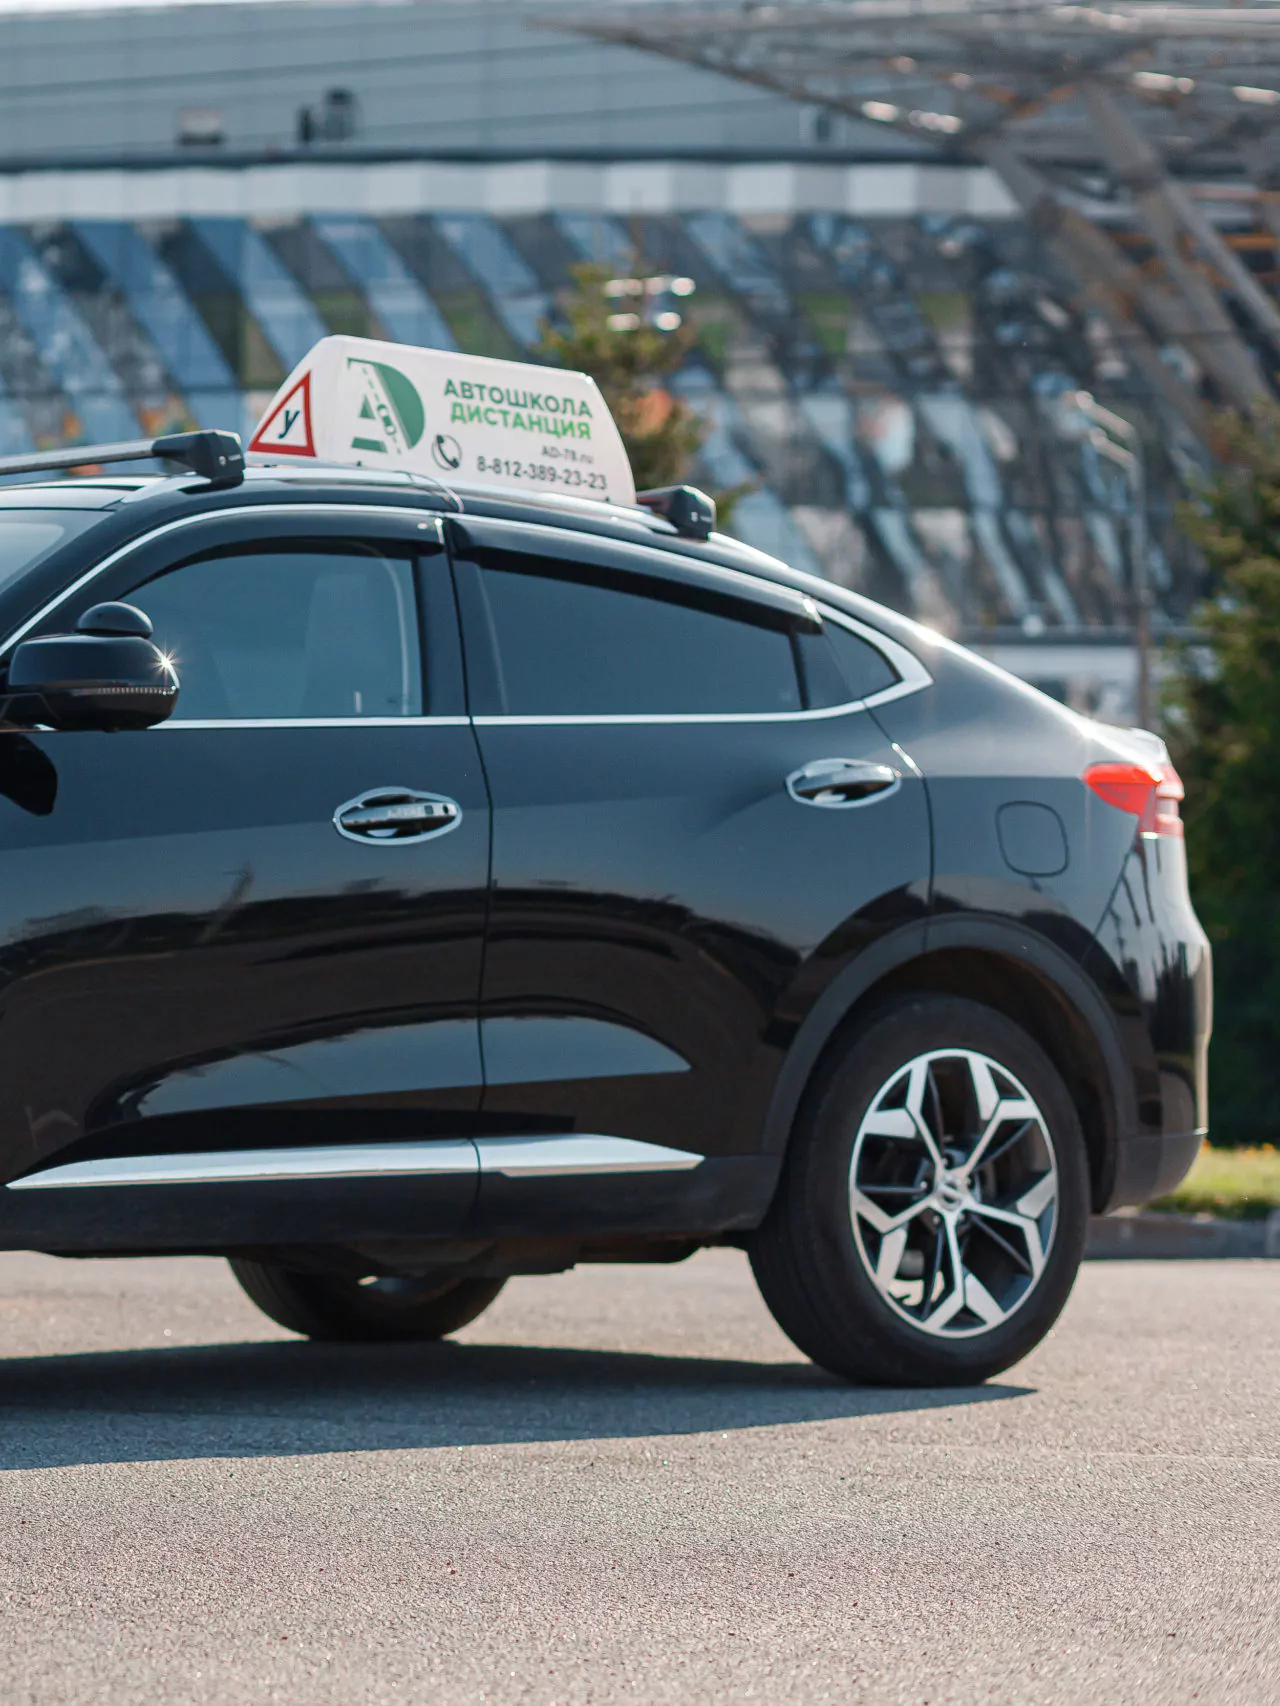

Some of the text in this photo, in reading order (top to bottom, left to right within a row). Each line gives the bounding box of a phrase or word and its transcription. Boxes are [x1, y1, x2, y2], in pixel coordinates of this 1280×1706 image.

[444, 378, 593, 418] АВТОШКОЛА
[450, 401, 592, 440] ДИСТАНЦИЯ
[477, 455, 608, 490] 8-812-389-23-23
